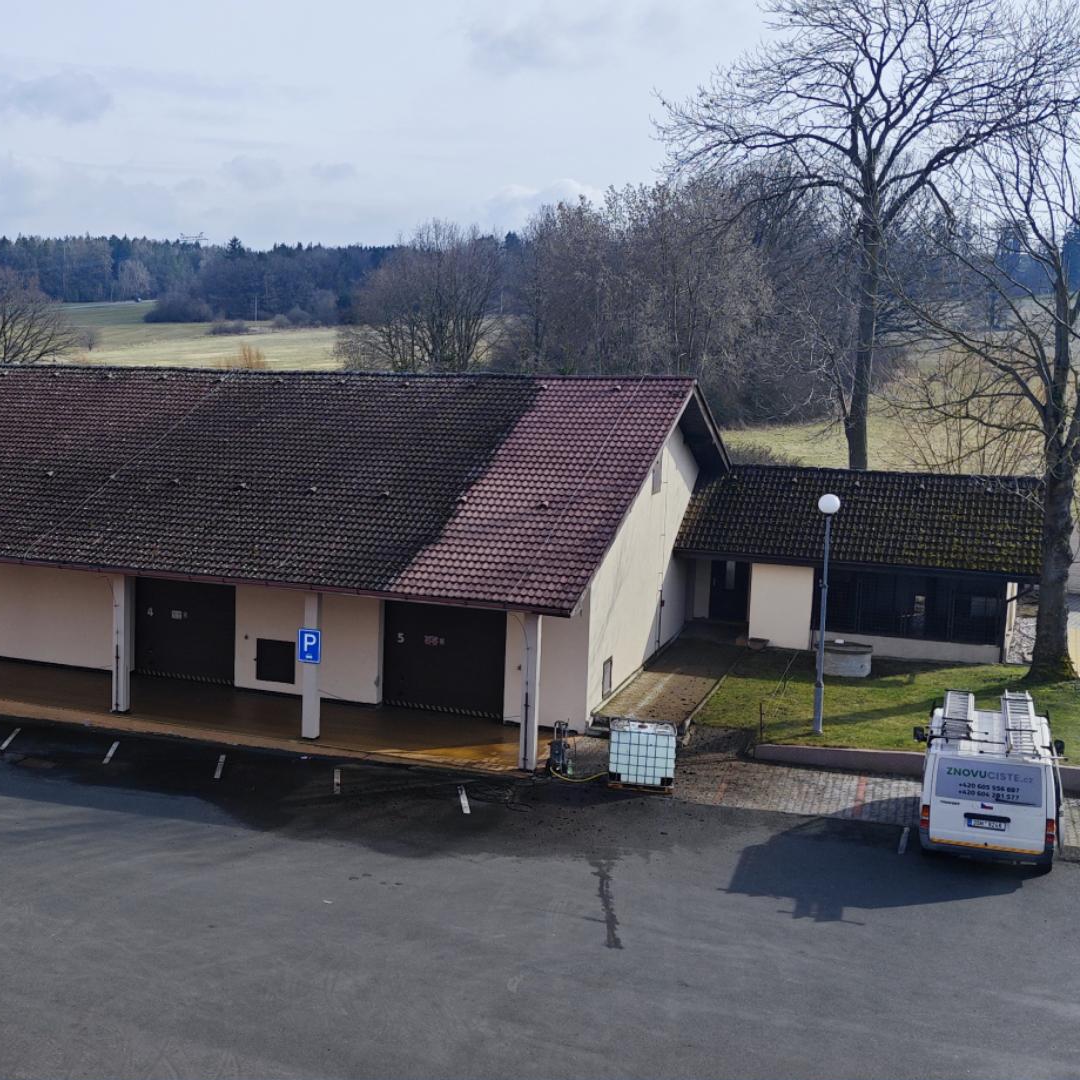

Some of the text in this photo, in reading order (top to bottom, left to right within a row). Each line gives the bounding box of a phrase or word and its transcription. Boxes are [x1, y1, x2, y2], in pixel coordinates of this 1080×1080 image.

[147, 607, 154, 617] 4
[304, 633, 317, 652] P
[397, 632, 405, 643] 5
